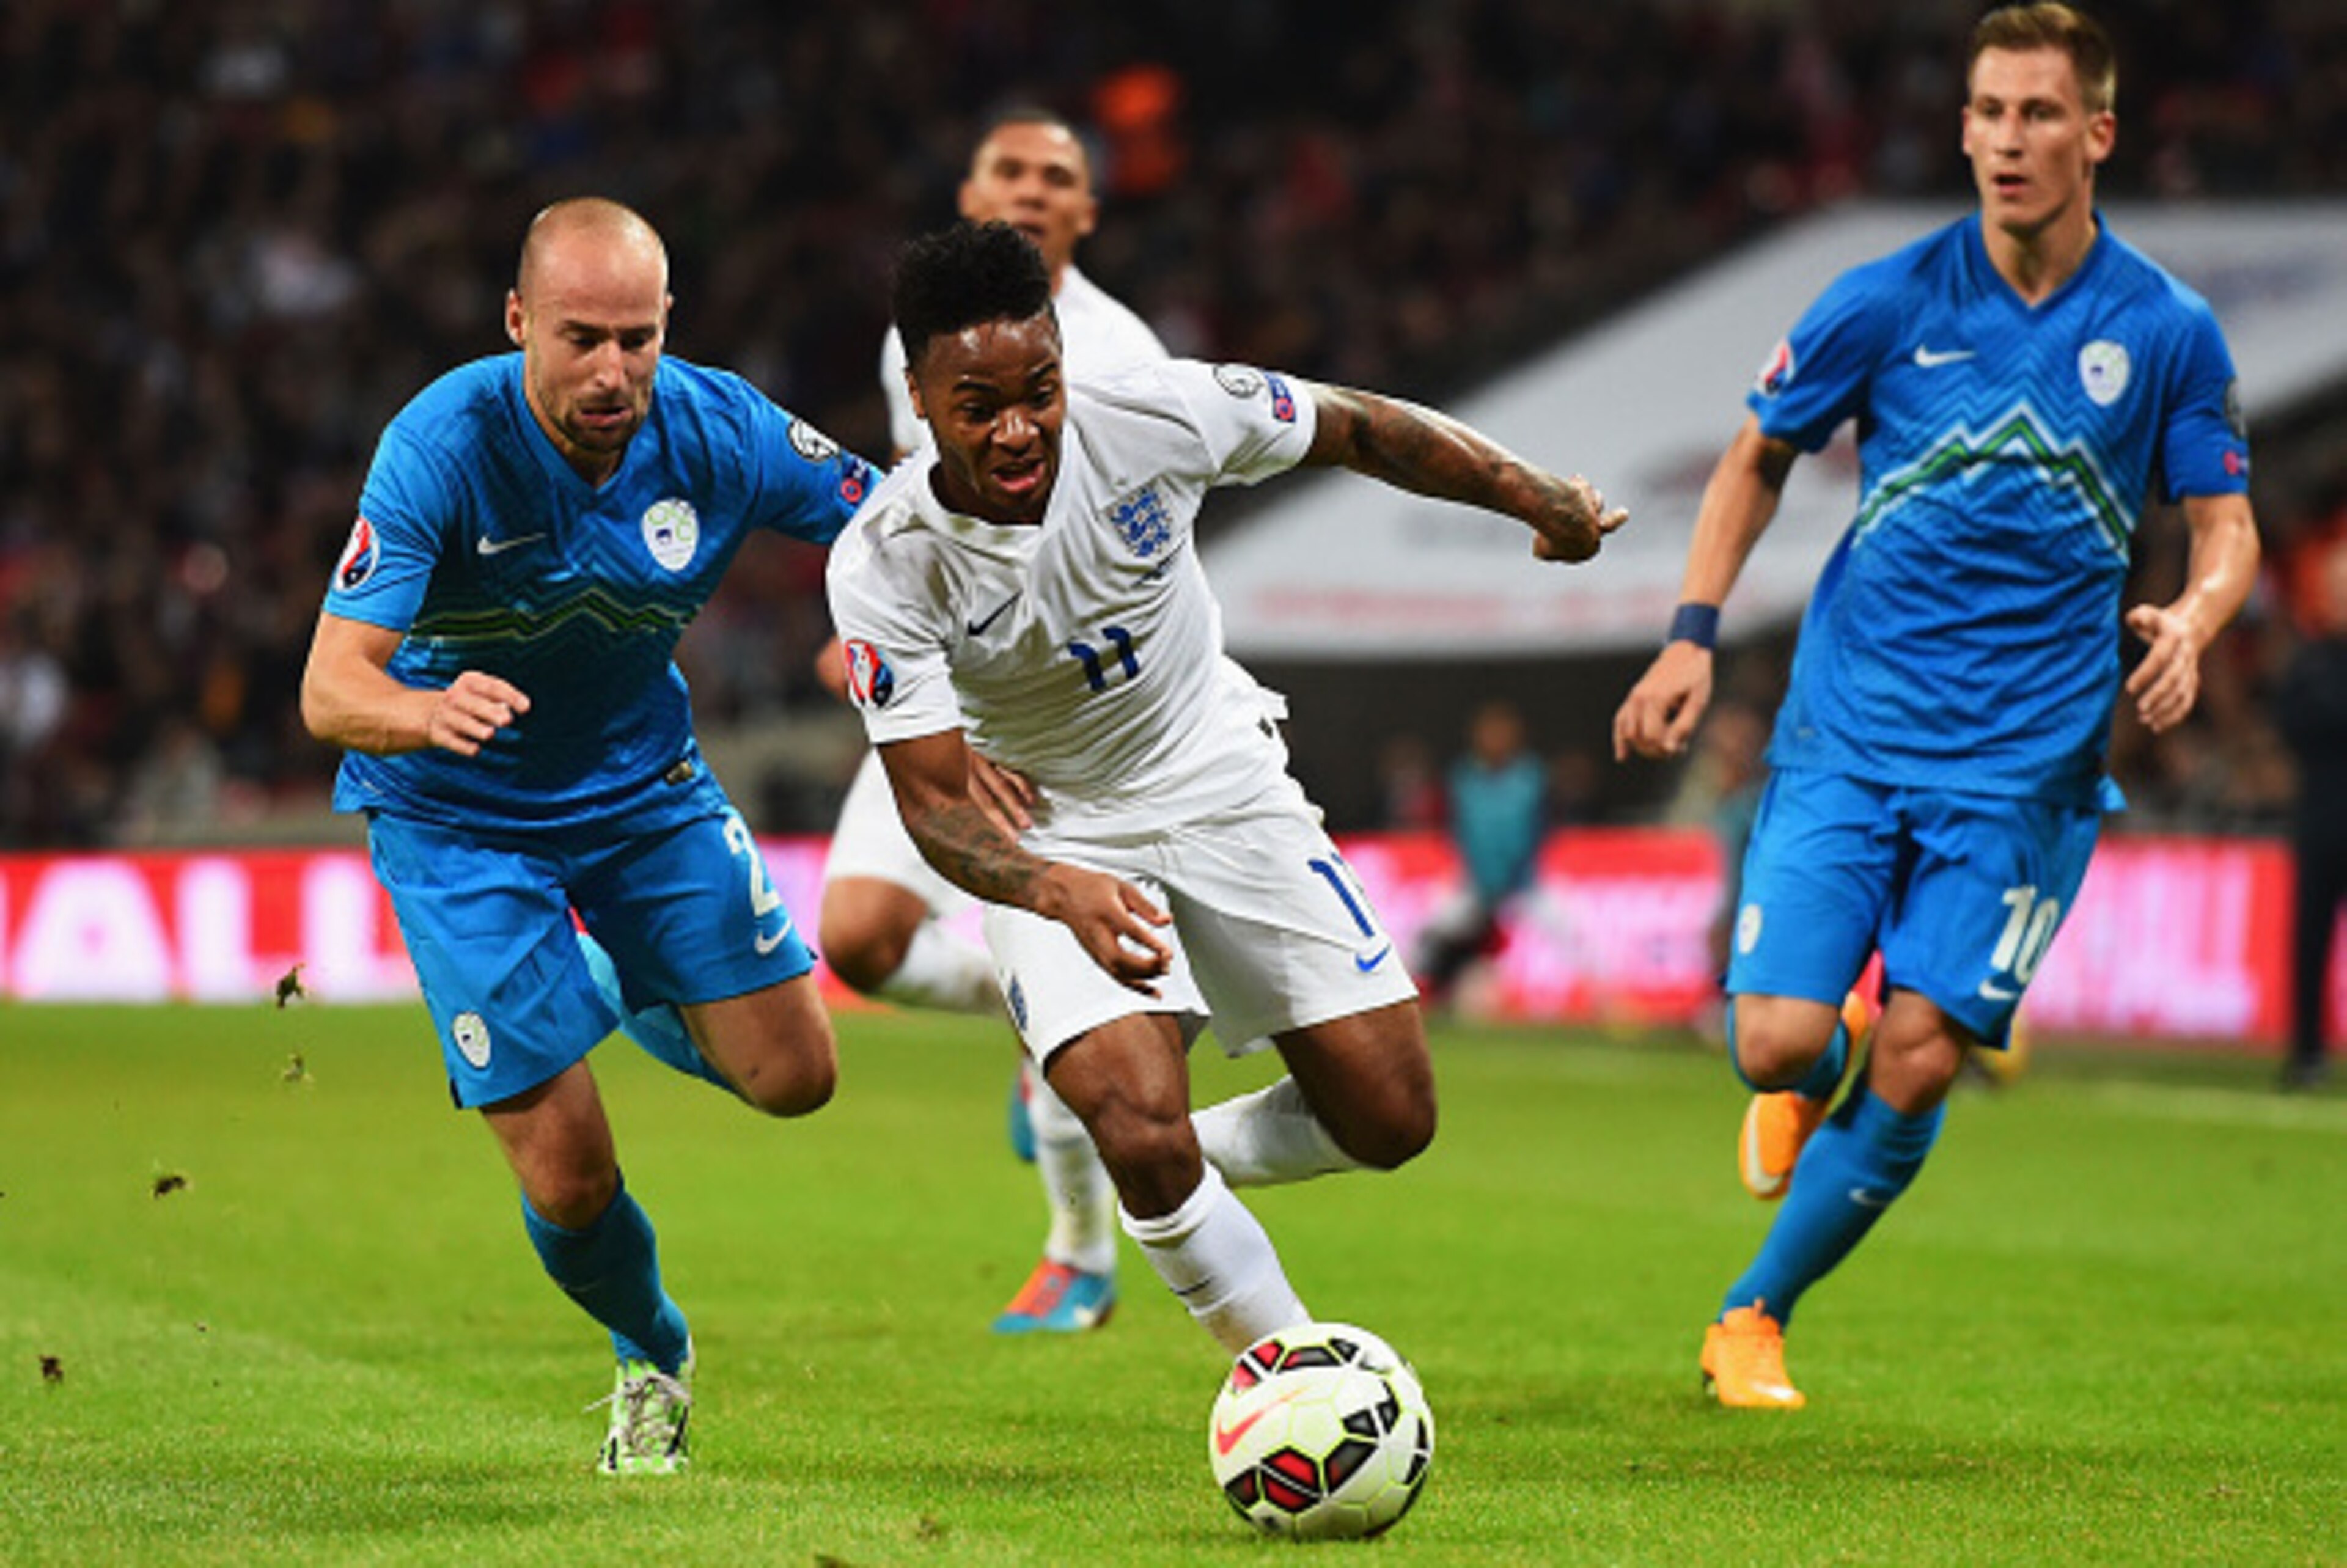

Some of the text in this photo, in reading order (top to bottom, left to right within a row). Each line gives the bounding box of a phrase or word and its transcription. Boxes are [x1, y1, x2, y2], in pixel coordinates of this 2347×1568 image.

[1068, 625, 1139, 691] 11
[722, 816, 781, 917] 2
[1307, 852, 1375, 938] 1
[0, 857, 423, 1003] ALL
[1989, 884, 2059, 984] 10
